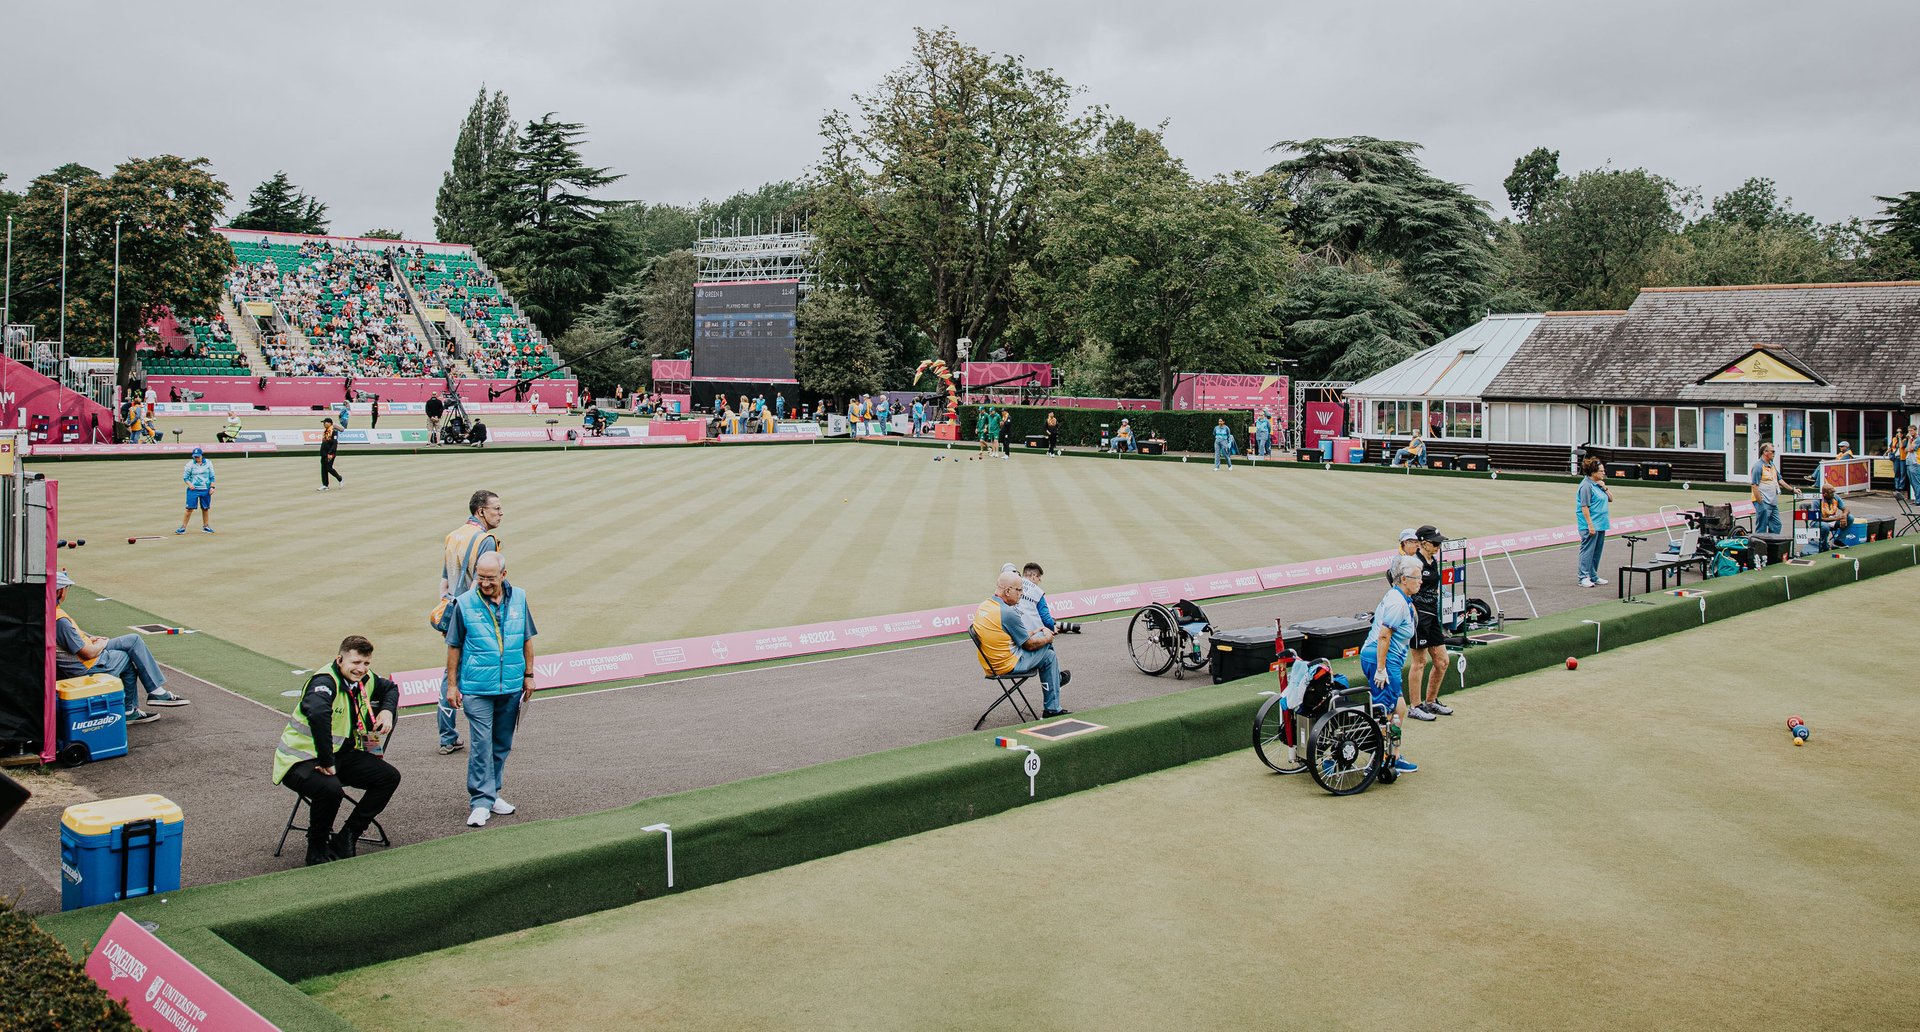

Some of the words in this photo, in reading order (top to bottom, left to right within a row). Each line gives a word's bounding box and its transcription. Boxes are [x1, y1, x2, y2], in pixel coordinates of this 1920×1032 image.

[1448, 571, 1453, 583] 2
[1055, 599, 1075, 611] 2022
[799, 631, 837, 645] #B2022
[569, 651, 634, 668] commonwealth
[589, 661, 619, 675] games
[402, 678, 442, 696] BIRMI
[72, 715, 115, 731] Lucozade
[1027, 759, 1038, 771] 18
[102, 939, 148, 982] LONGINES
[162, 984, 200, 1020] UNIVERSITY
